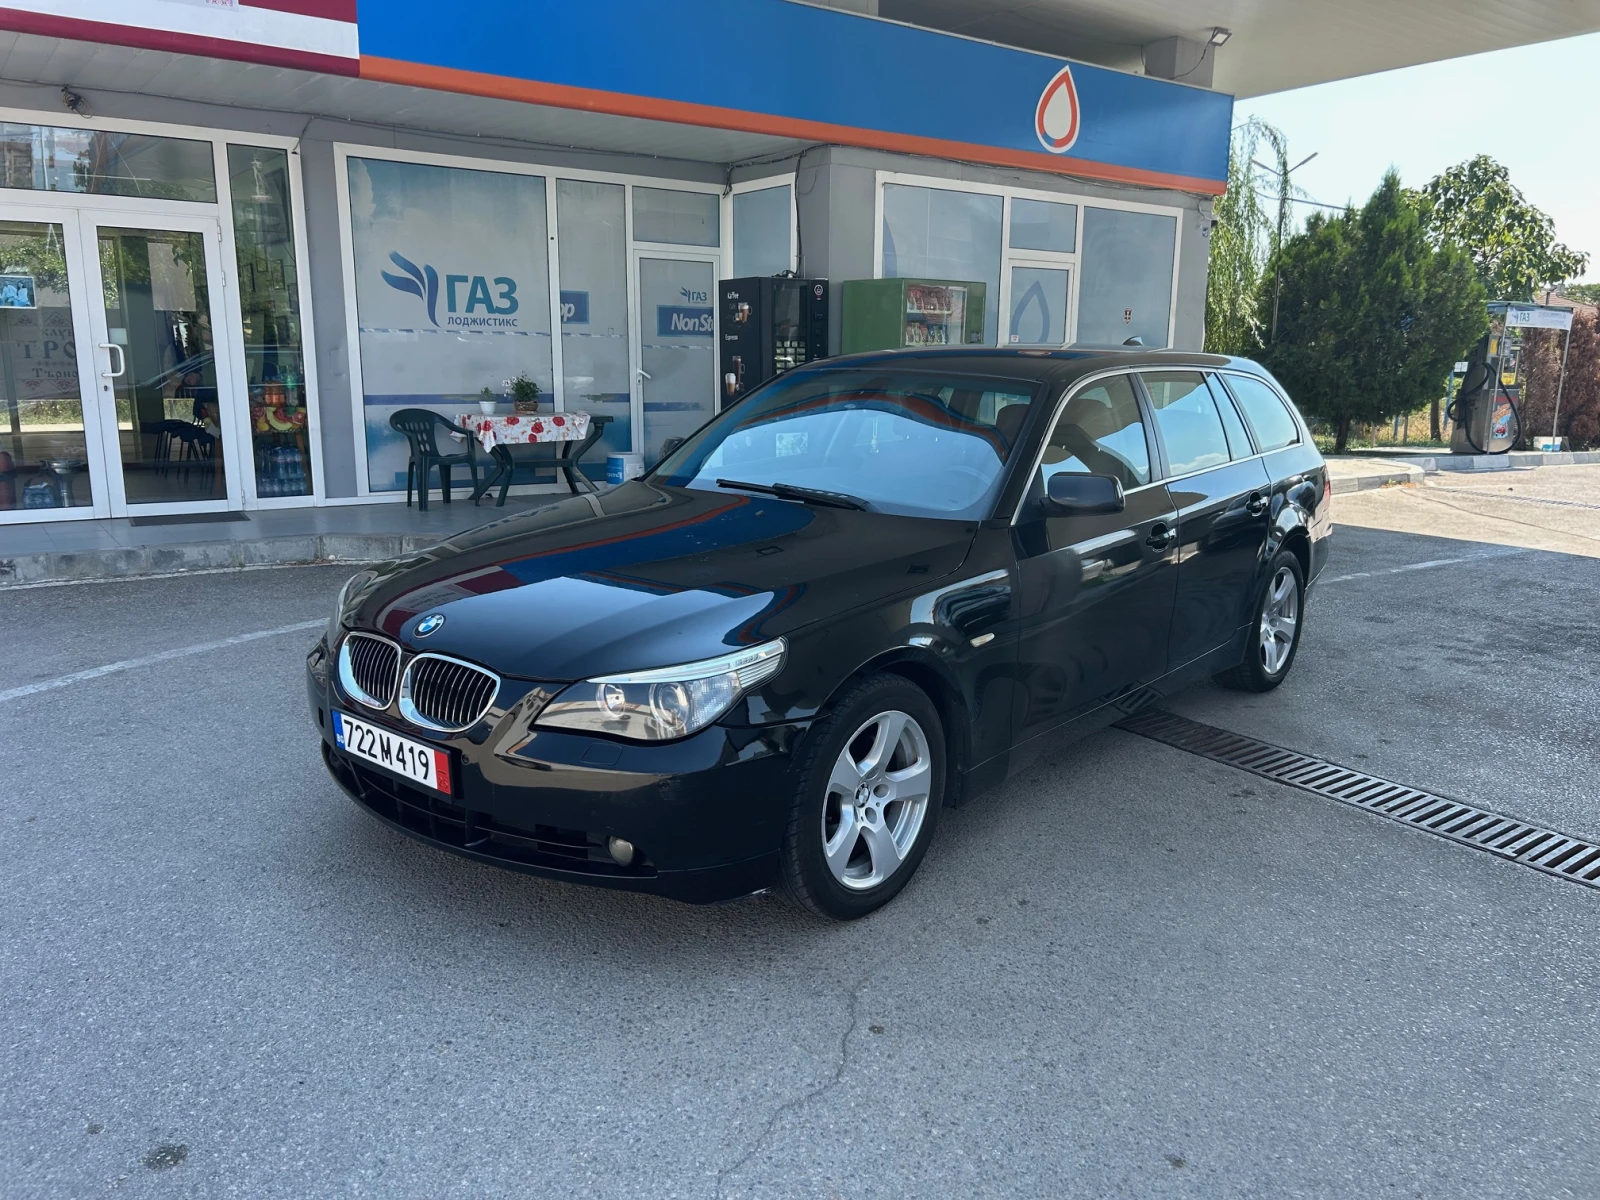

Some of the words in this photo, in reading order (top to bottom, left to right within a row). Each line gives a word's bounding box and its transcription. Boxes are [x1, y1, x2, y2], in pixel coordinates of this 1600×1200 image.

[446, 274, 519, 315] ГАЗ
[691, 291, 707, 301] ГАЗ
[447, 316, 518, 328] ЛОДЖИСТИКС
[671, 313, 699, 331] Non
[699, 314, 714, 332] St
[1519, 312, 1530, 322] ГАЗ
